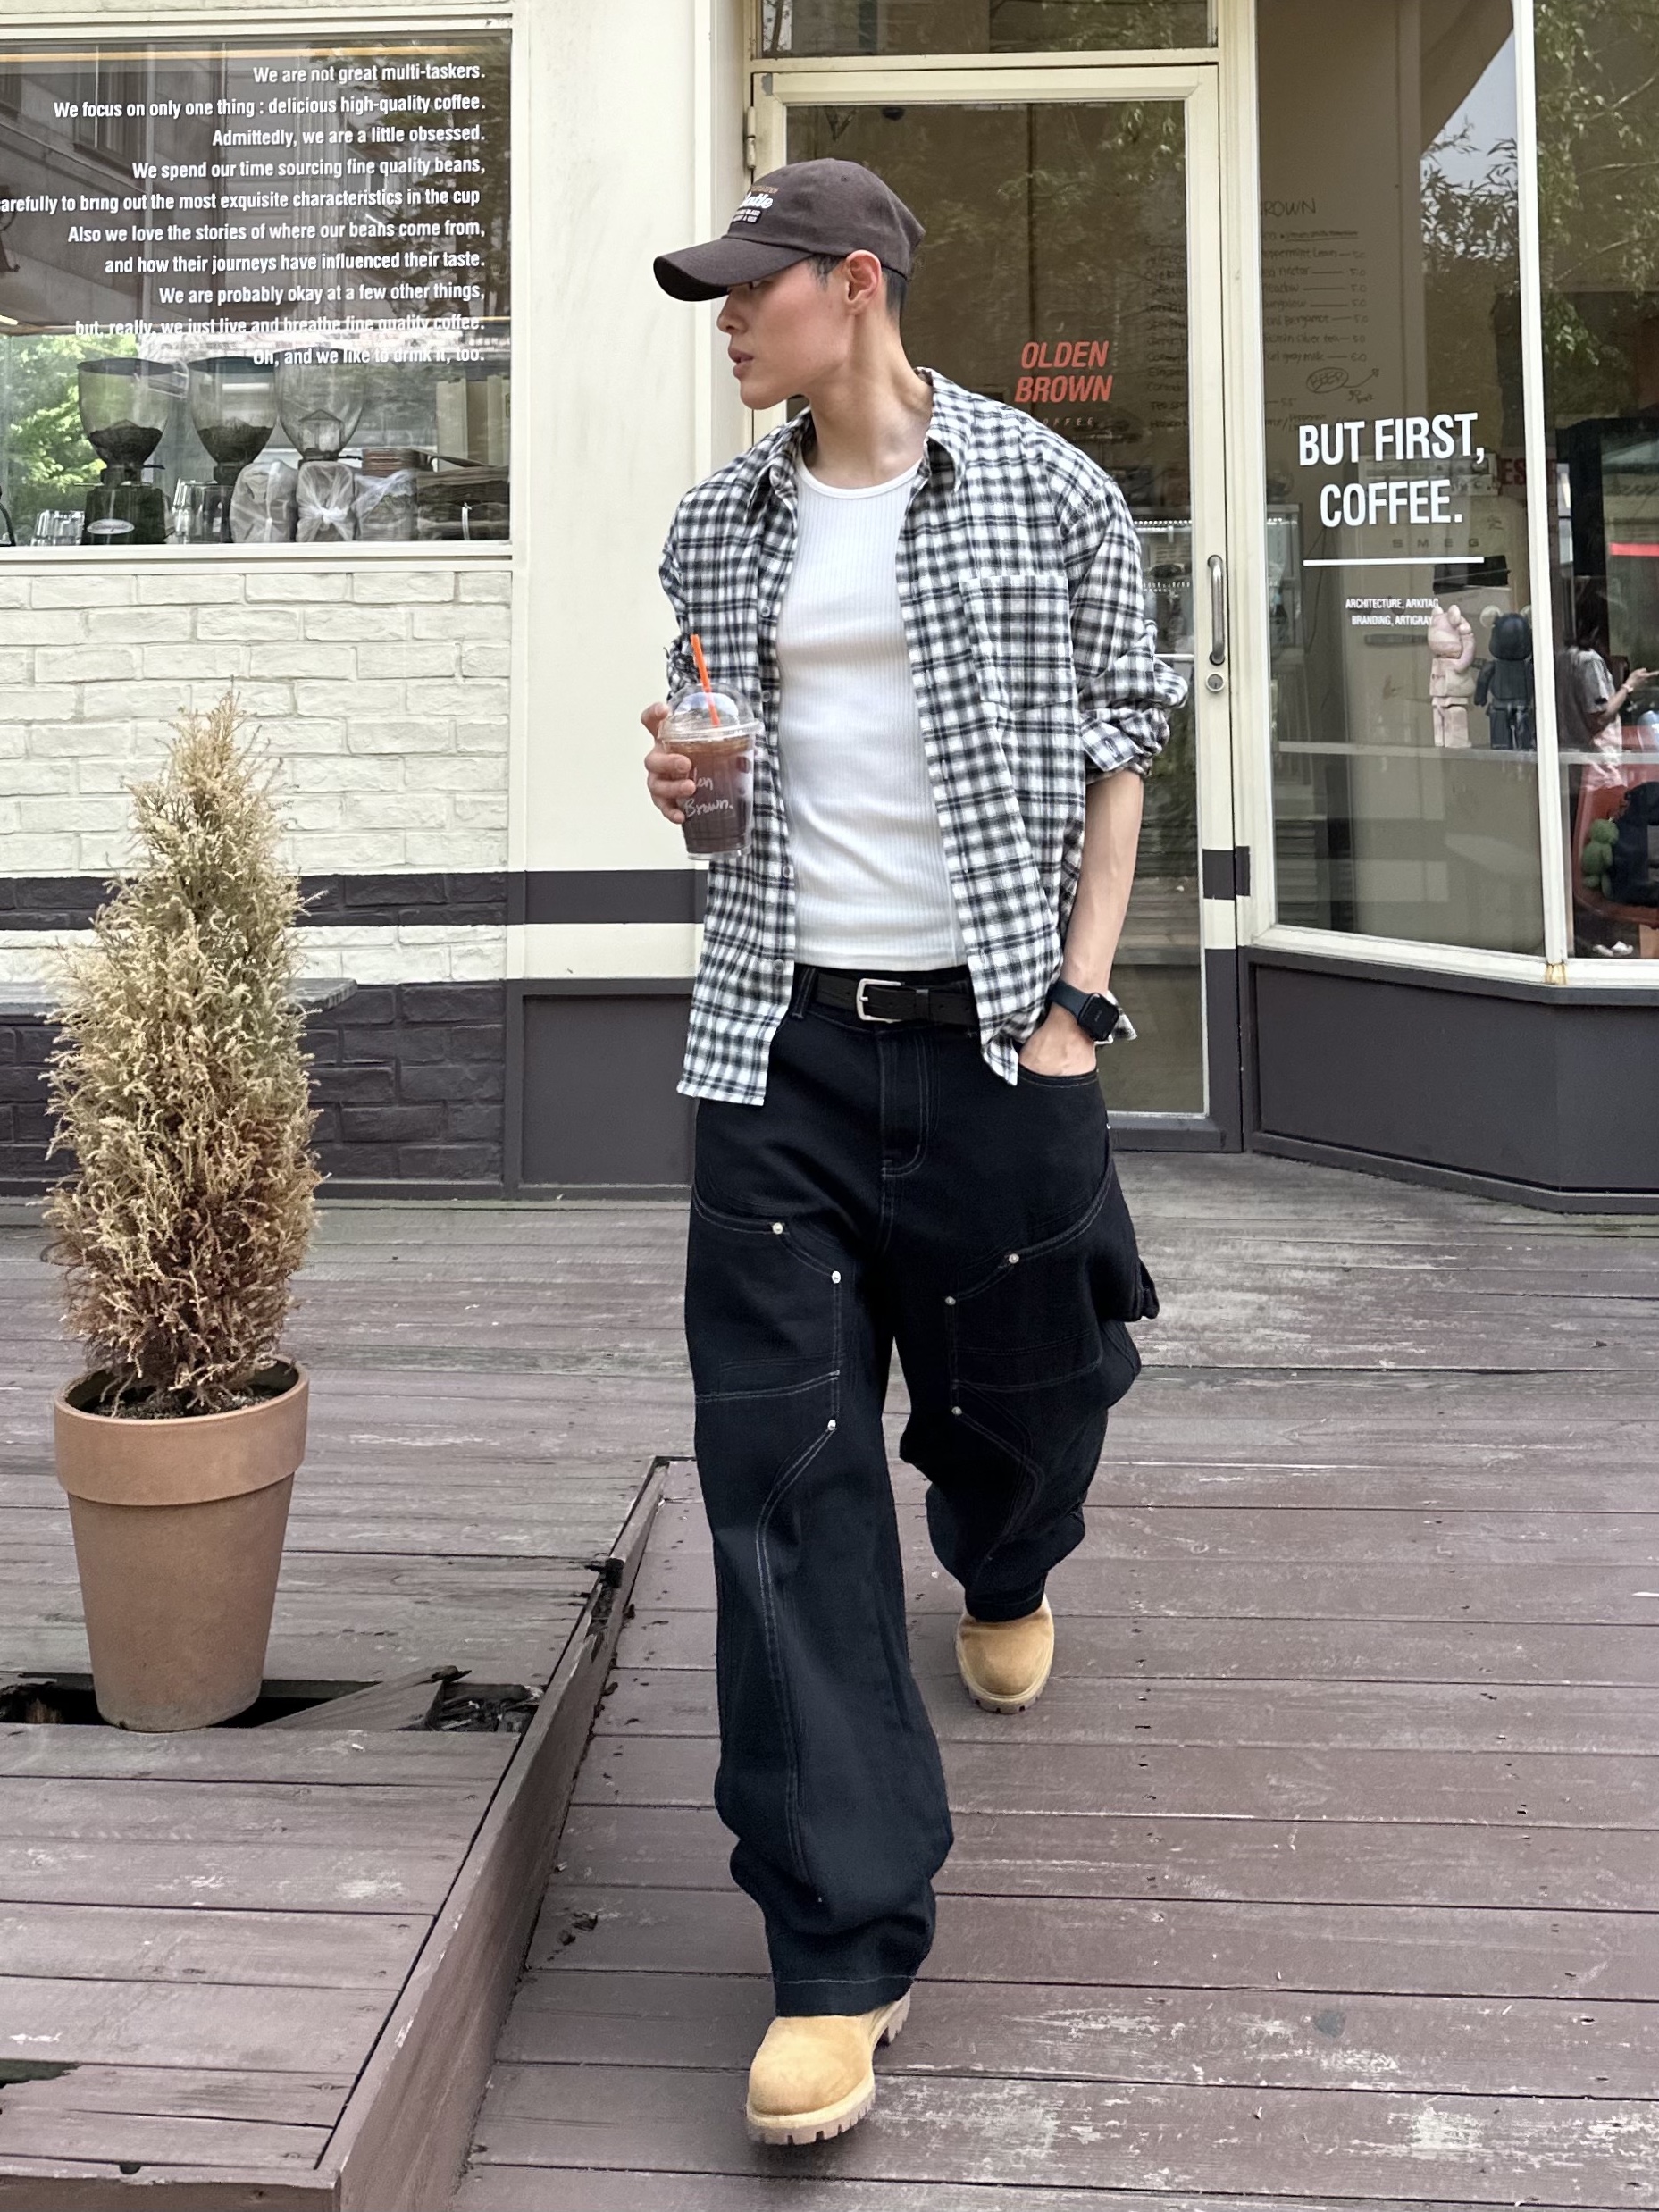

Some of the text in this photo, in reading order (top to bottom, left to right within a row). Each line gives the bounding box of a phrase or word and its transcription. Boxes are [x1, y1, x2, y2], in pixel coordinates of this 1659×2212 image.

[253, 63, 486, 84] We are not great multi-taskers.
[54, 94, 486, 119] We focus on only one thing : delicious high-quality coffee.
[213, 124, 485, 147] Admittedly, we are a little obsessed.
[132, 157, 485, 181] We spend our time sourcing fine quality beans,
[0, 189, 481, 214] arefully to bring out the most exquisite characteristics in the cup
[1263, 198, 1316, 217] ROWN
[68, 220, 485, 242] Also we love the stories of where our beans come from,
[105, 251, 485, 274] and how their journeys have influenced their taste.
[159, 282, 485, 306] We are probably okay at a few other things,
[161, 322, 183, 335] we
[220, 318, 247, 333] live
[251, 317, 279, 332] and
[283, 316, 341, 331] breathe
[346, 316, 373, 331] fine
[433, 314, 485, 330] coffee.
[253, 350, 279, 367] Oh,
[284, 348, 313, 364] and
[315, 350, 339, 364] we
[343, 347, 370, 364] like
[1021, 340, 1110, 369] OLDEN
[1014, 374, 1113, 403] BROWN
[1043, 417, 1094, 427] OFFEE
[1299, 412, 1486, 466] BUT FIRST,
[1320, 479, 1463, 528] COFFEE.
[1345, 598, 1405, 609] ARCHITECTURE,
[1351, 615, 1394, 627] BRANDING,
